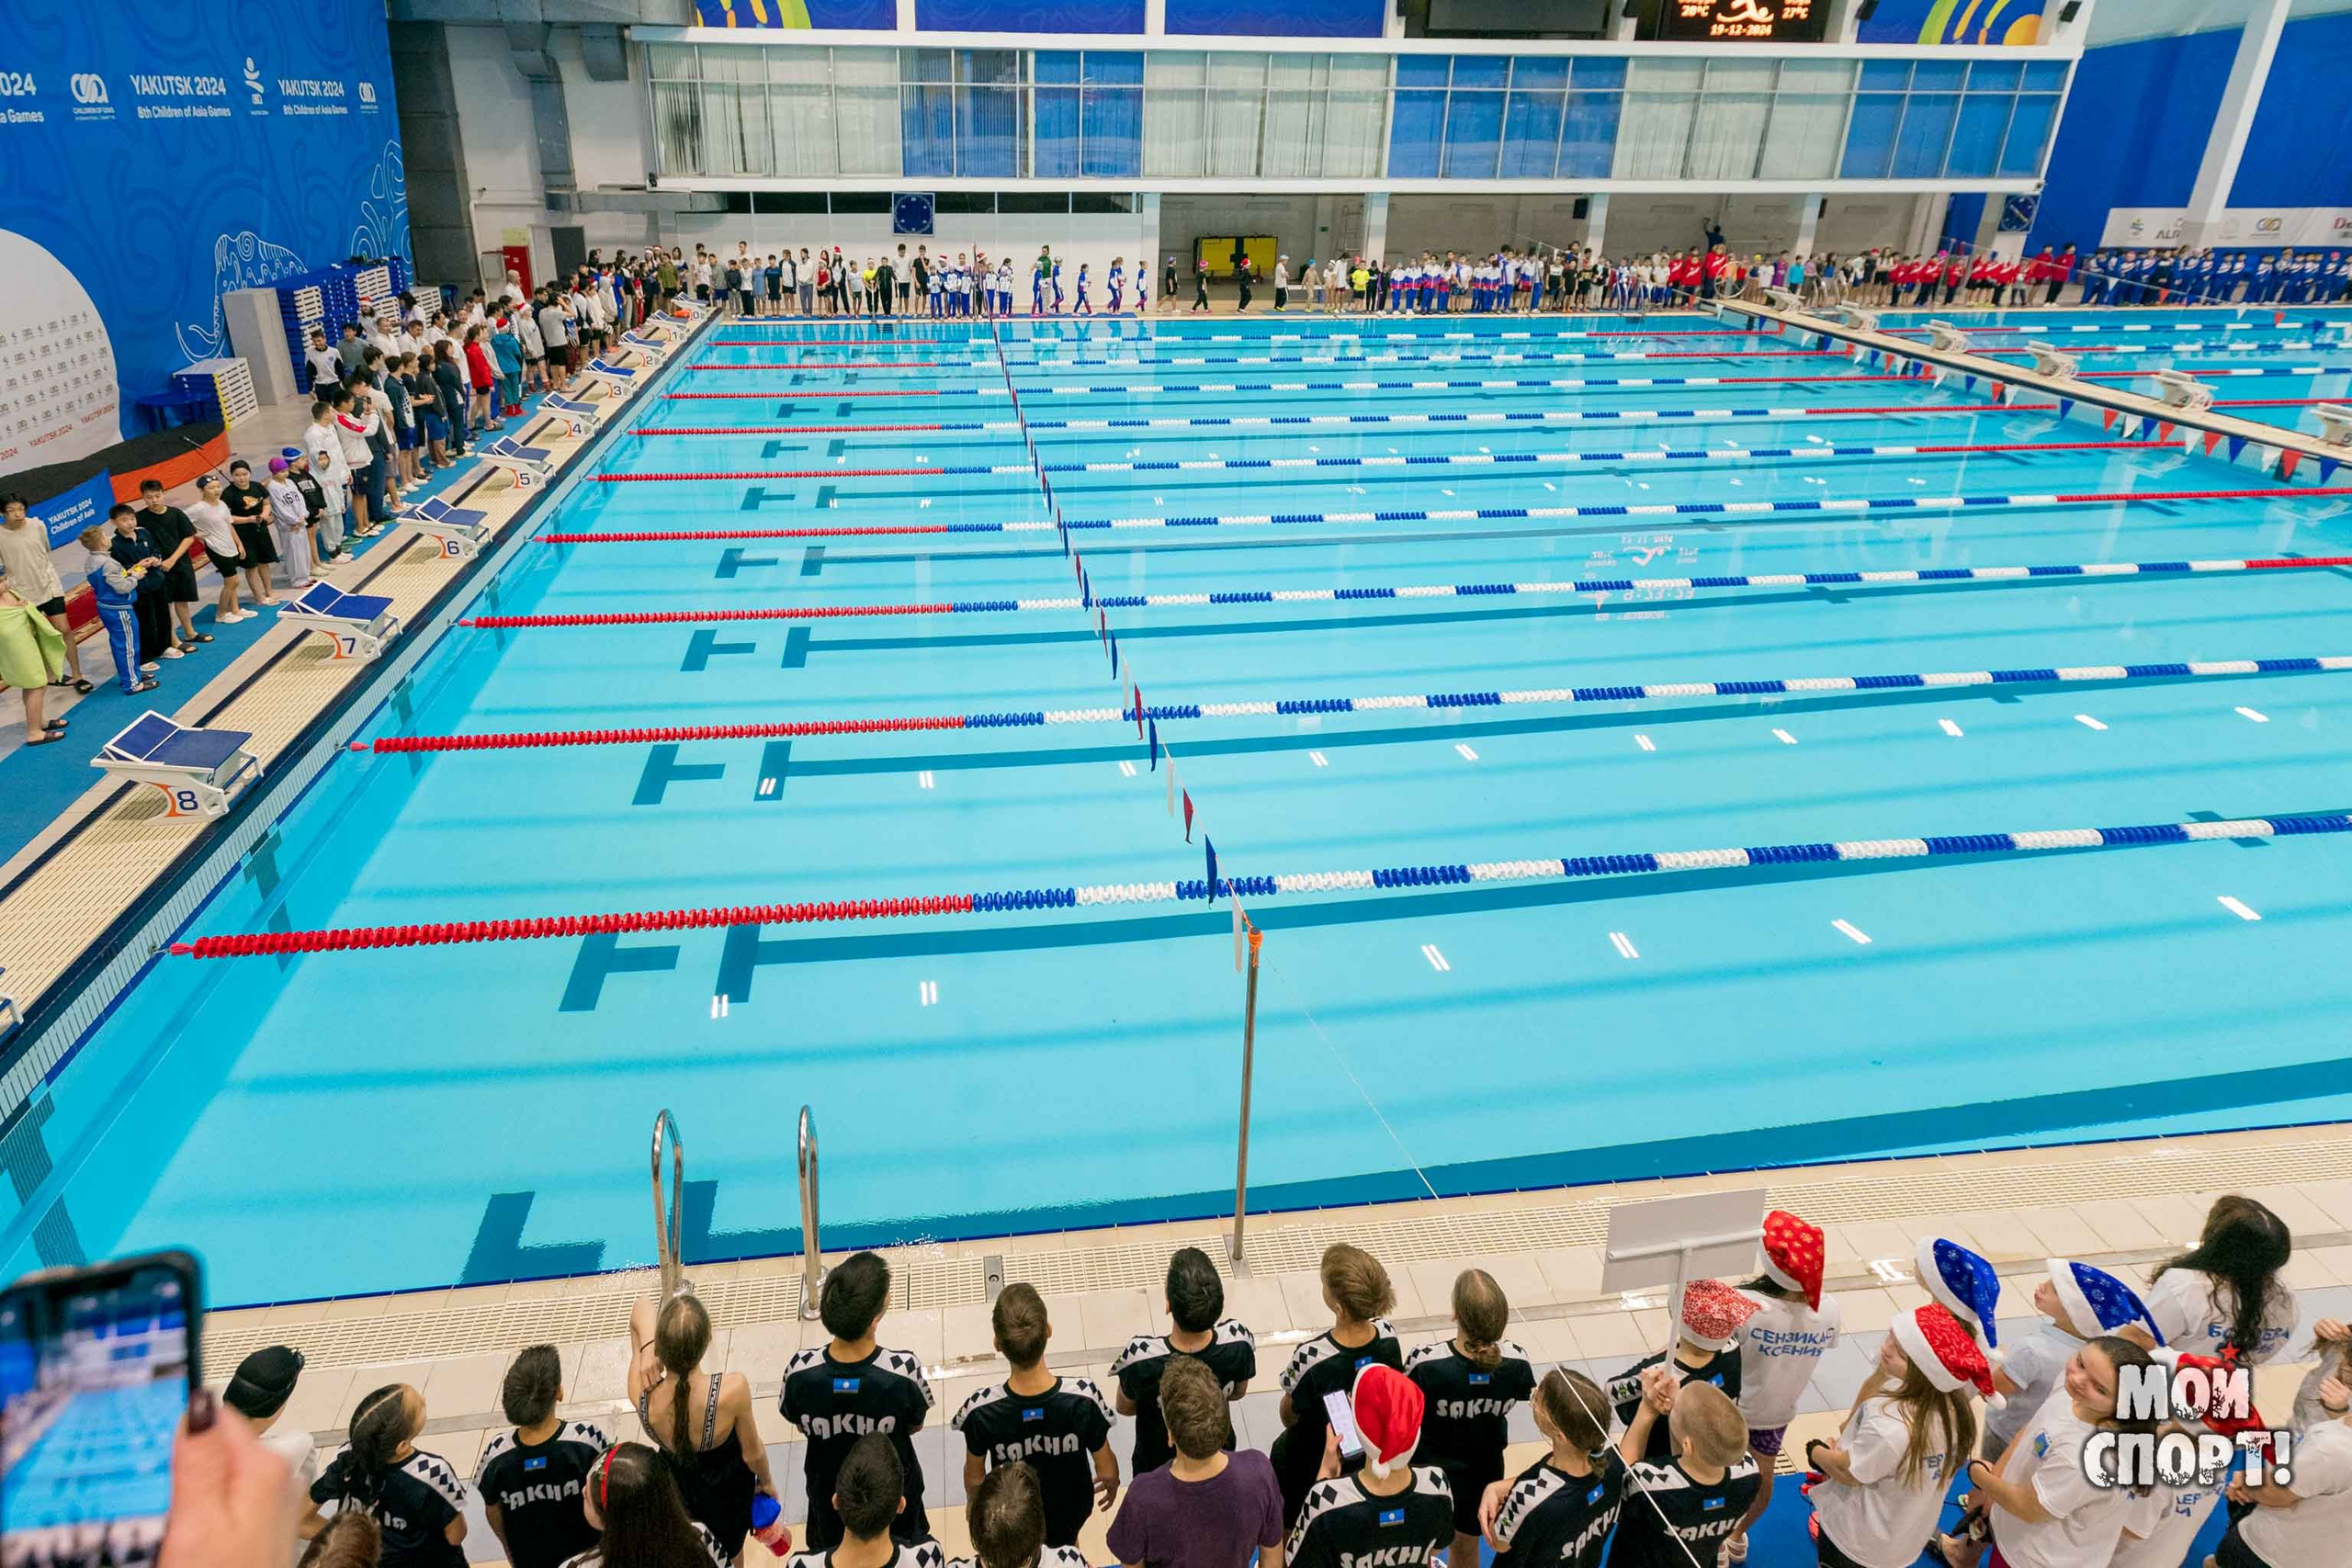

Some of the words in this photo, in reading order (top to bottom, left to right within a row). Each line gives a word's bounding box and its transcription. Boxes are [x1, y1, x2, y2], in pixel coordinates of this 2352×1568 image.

[1710, 24, 1772, 36] 19-12-2024
[0, 73, 37, 96] 024
[130, 74, 195, 96] YAKUTSK
[194, 76, 227, 96] 2024
[277, 79, 322, 96] YAKUTSK
[322, 81, 345, 96] 2024
[7, 108, 45, 123] Games
[137, 106, 153, 118] 8th
[152, 105, 184, 118] Children
[184, 105, 192, 117] of
[192, 105, 208, 118] Asia
[208, 105, 232, 118] Games
[673, 331, 678, 340] 1
[646, 355, 652, 365] 2
[613, 386, 622, 395] 3
[28, 431, 57, 448] YAKUTSK
[56, 423, 74, 437] 2024
[572, 423, 582, 434] 4
[0, 447, 18, 460] 2024
[520, 473, 530, 485] 5
[48, 506, 79, 525] YAKUTSK
[77, 498, 93, 513] 2024
[51, 518, 78, 536] Children
[83, 507, 96, 520] Asia
[447, 540, 459, 555] 6
[342, 637, 356, 653] 7
[176, 790, 198, 811] 8
[1435, 1397, 1517, 1420] SAKHA
[800, 1412, 896, 1440] SAKHA
[995, 1432, 1080, 1461] SAKHA
